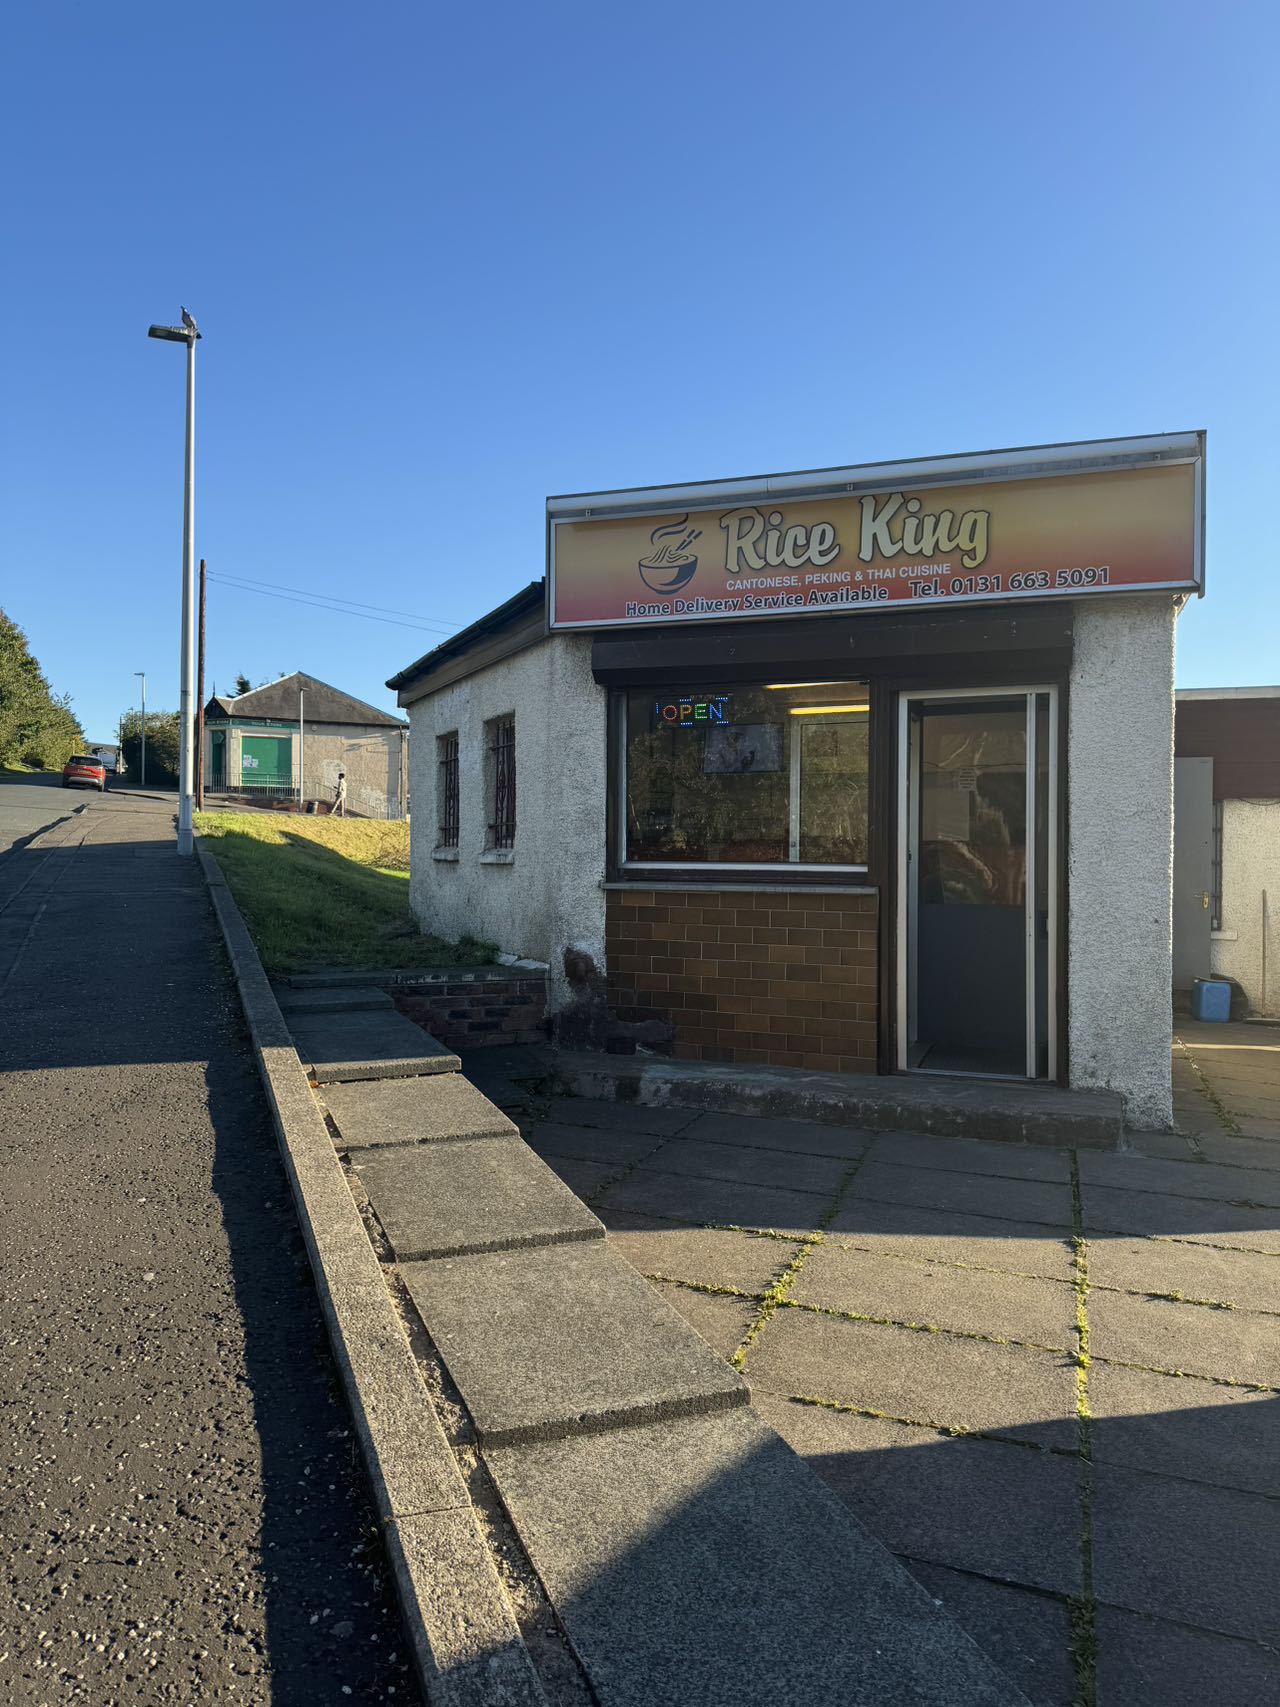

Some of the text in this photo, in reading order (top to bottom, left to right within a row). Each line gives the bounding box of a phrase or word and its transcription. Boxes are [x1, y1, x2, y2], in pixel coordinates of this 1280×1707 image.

[719, 491, 991, 574] Rice King
[726, 563, 952, 591] CANTONESE, PEKING & THAI CUISINE
[909, 566, 1110, 598] Tel. 0131 663 5091
[626, 584, 889, 616] Home Delivery Service Available
[663, 703, 722, 720] OPEN
